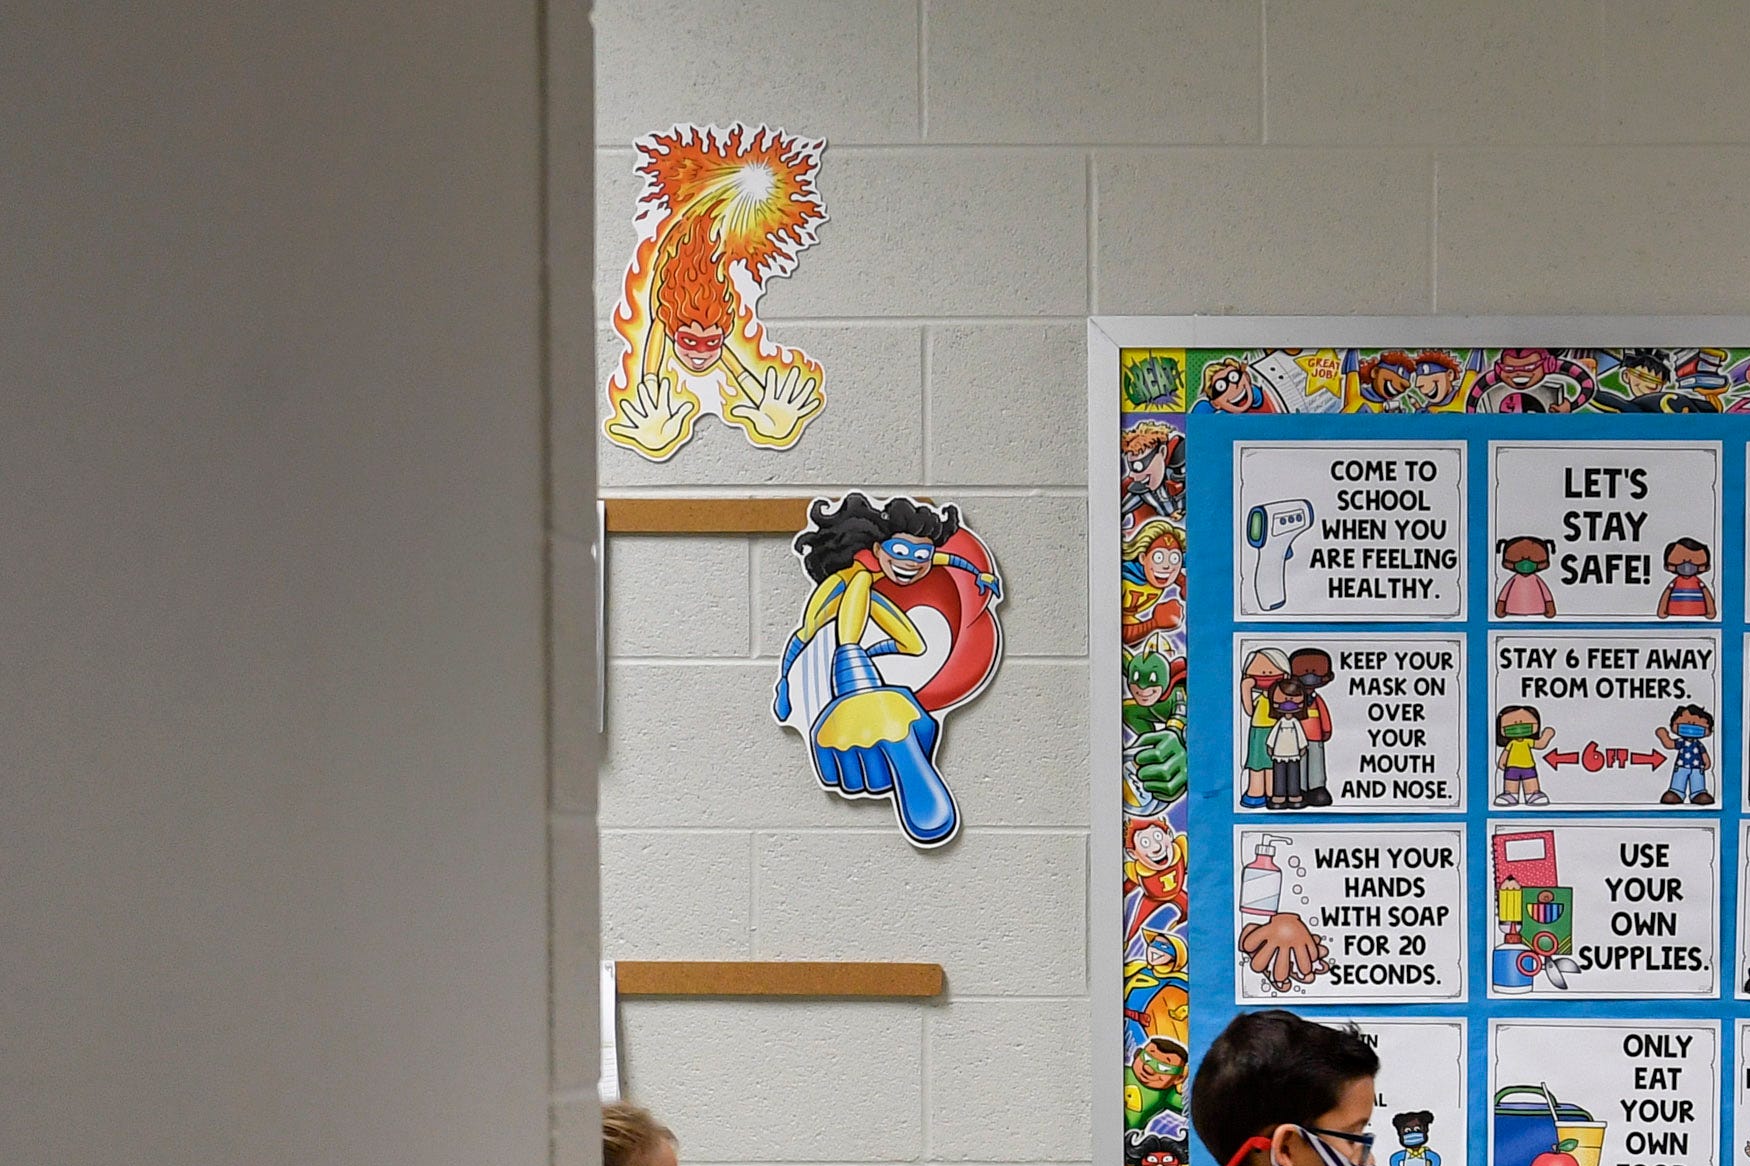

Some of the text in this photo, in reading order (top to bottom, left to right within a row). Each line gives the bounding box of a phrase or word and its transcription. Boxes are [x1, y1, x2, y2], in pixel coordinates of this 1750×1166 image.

[1308, 358, 1340, 369] GREAT
[1311, 369, 1338, 380] JOB!
[1330, 459, 1438, 482] COME TO
[1564, 467, 1648, 500] LET'S
[1337, 489, 1431, 512] SCHOOL
[1321, 518, 1447, 541] WHEN YOU
[1563, 510, 1648, 543] STAY
[1309, 547, 1458, 570] ARE FEELING
[1560, 553, 1651, 586] SAFE!
[1328, 577, 1440, 600] HEALTHY.
[1340, 651, 1454, 671] KEEP YOUR
[1499, 647, 1713, 670] STAY 6 FEET AWAY
[1348, 677, 1446, 697] MASK ON
[1521, 676, 1692, 700] FROM OTHERS.
[1367, 702, 1426, 722] OVER
[1367, 728, 1427, 748] YOUR
[1359, 754, 1435, 774] MOUTH
[1582, 741, 1629, 774] 6FT
[1340, 779, 1453, 800] AND NOSE.
[1314, 847, 1455, 870] WASH YOUR
[1620, 842, 1670, 869] USE
[1344, 876, 1426, 899] HANDS
[1604, 877, 1684, 903] YOUR
[1320, 905, 1450, 928] WITH SOAP
[1611, 911, 1677, 937] OWN
[1344, 934, 1426, 956] FOR 20
[1578, 946, 1710, 973] SUPPLIES.
[1330, 964, 1442, 987] SECONDS.
[1623, 1033, 1693, 1059] ONLY
[1634, 1067, 1683, 1091] EAT
[1620, 1099, 1695, 1124] YOUR
[1625, 1131, 1689, 1156] OWN
